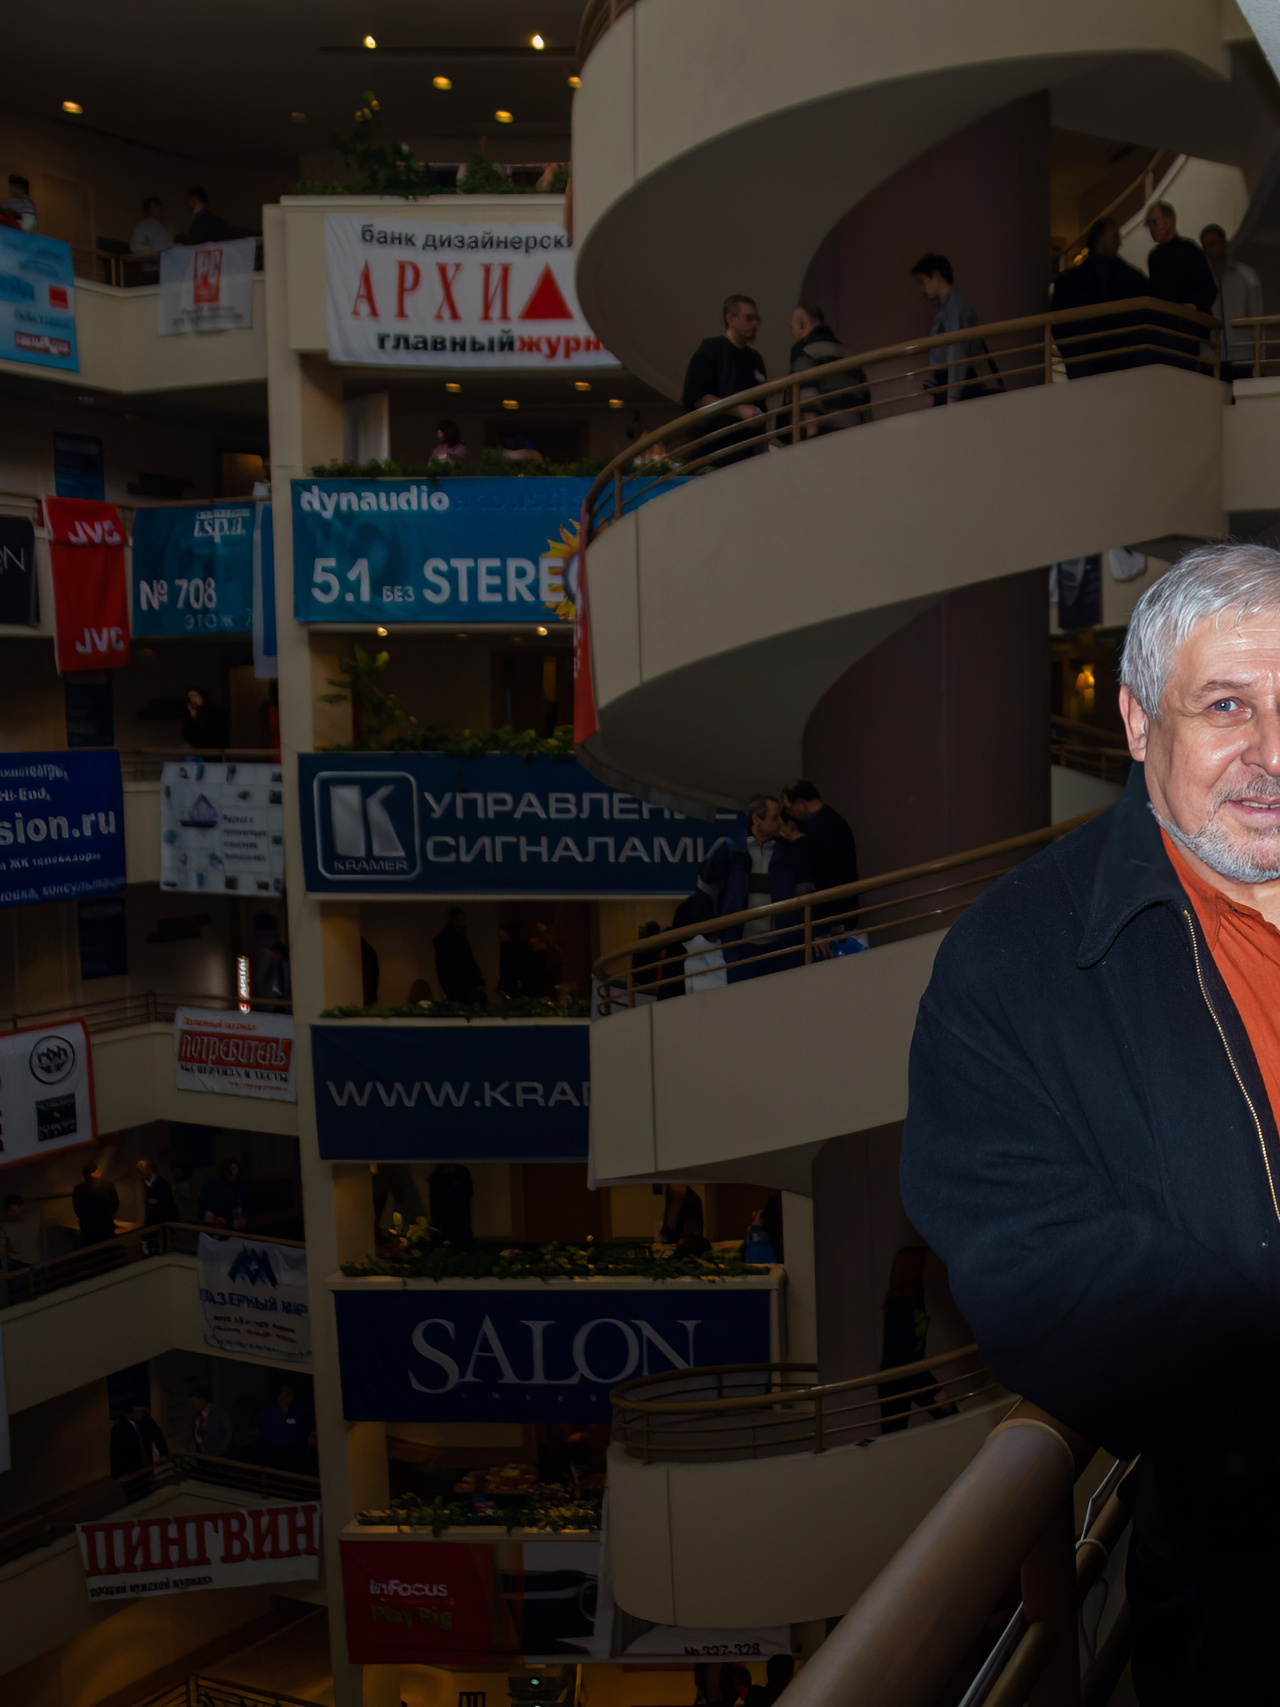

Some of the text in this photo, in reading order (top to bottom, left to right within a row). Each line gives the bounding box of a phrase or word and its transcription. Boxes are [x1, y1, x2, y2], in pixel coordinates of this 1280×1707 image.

[361, 223, 416, 248] банк
[299, 485, 450, 519] dynaudio
[67, 519, 122, 545] JVC
[174, 576, 218, 610] 708
[311, 557, 371, 604] 5.1
[381, 585, 416, 602] БЕЗ
[75, 626, 126, 654] JVC
[423, 791, 738, 821] УПРАВЛЕН
[333, 858, 409, 873] KRAMER
[407, 1313, 703, 1395] SALON
[80, 1503, 319, 1577] ПИНГВИН
[369, 1577, 450, 1598] InFocus
